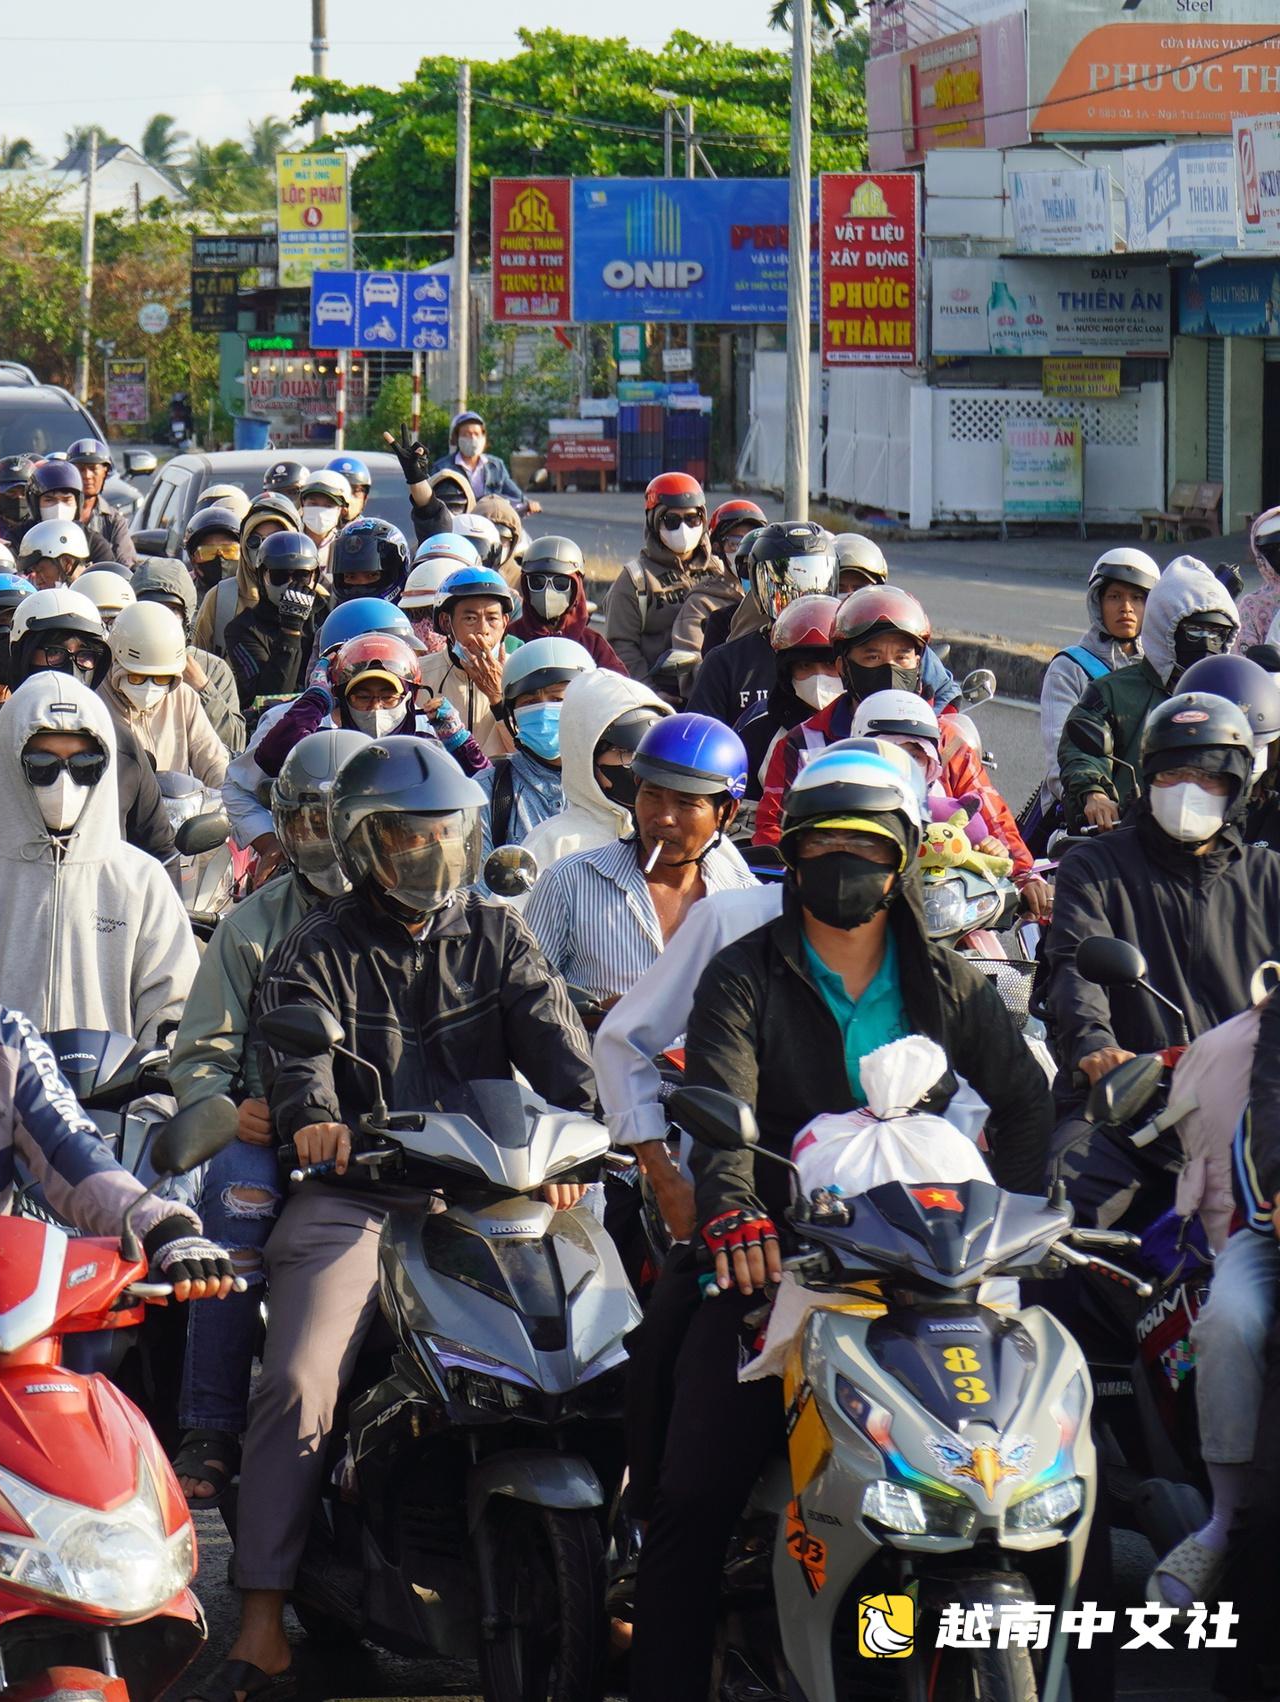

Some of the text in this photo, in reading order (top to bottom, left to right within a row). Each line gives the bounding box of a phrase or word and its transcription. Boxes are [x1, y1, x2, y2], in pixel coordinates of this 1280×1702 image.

[1186, 36, 1219, 48] HÀNG
[1088, 56, 1223, 93] PHƯỚC
[282, 181, 342, 208] LỘC PHÁT
[835, 222, 904, 244] VẬT LIỆU
[500, 255, 564, 266] VLXD & TTNT
[830, 248, 908, 269] XÂY DỰNG
[500, 274, 538, 292] TRUNG
[602, 260, 704, 290] ONIP
[829, 276, 910, 308] PHƯỚC
[1058, 286, 1163, 312] THIÊN ÂN
[940, 306, 980, 315] PILSNER
[827, 315, 911, 346] THÀNH
[60, 1052, 97, 1061] HONDA
[490, 1224, 538, 1234] HONDA
[928, 1323, 983, 1334] HONDA
[25, 1383, 81, 1394] HONDA
[1096, 1382, 1134, 1397] YAMAHA
